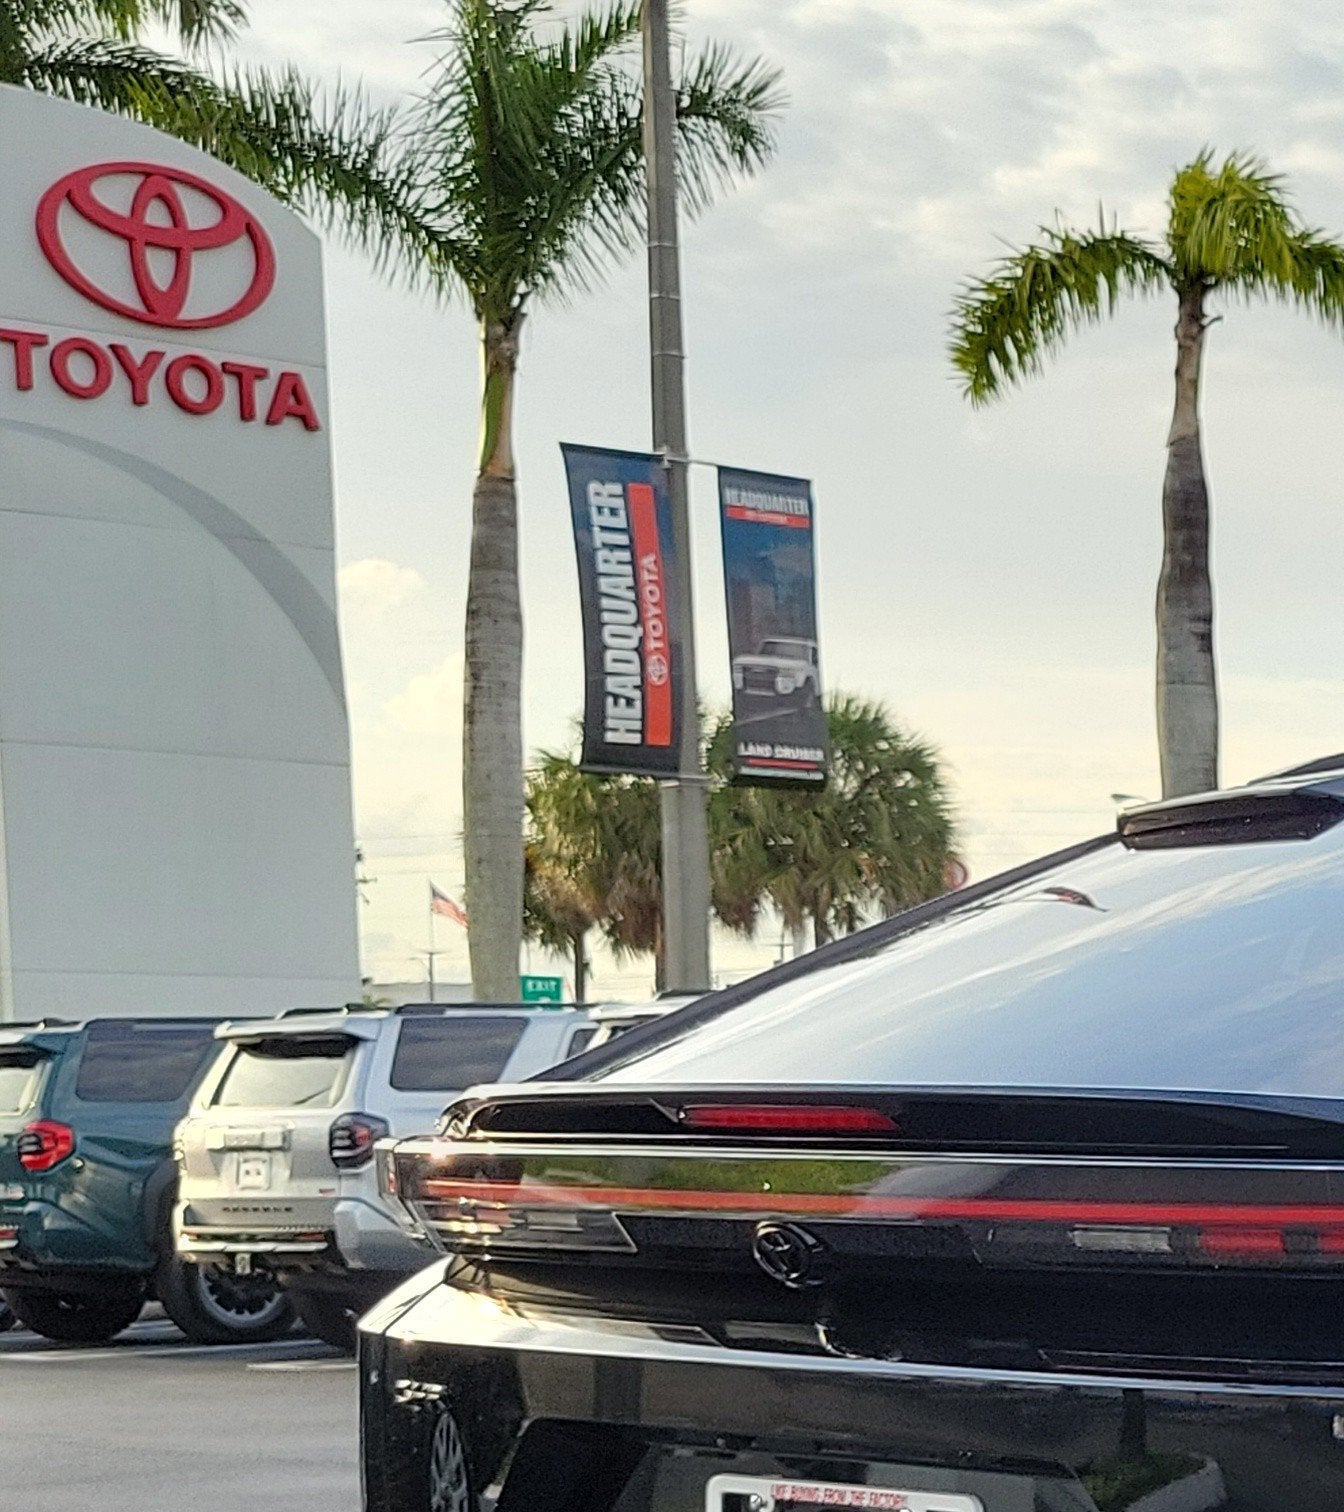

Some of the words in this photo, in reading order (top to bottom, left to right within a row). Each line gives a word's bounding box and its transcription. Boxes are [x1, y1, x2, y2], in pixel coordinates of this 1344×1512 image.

[0, 328, 321, 432] TOYOTA
[587, 479, 643, 745] HEADQUARTER
[640, 553, 665, 651] TOYOTA
[737, 741, 773, 757] LAND
